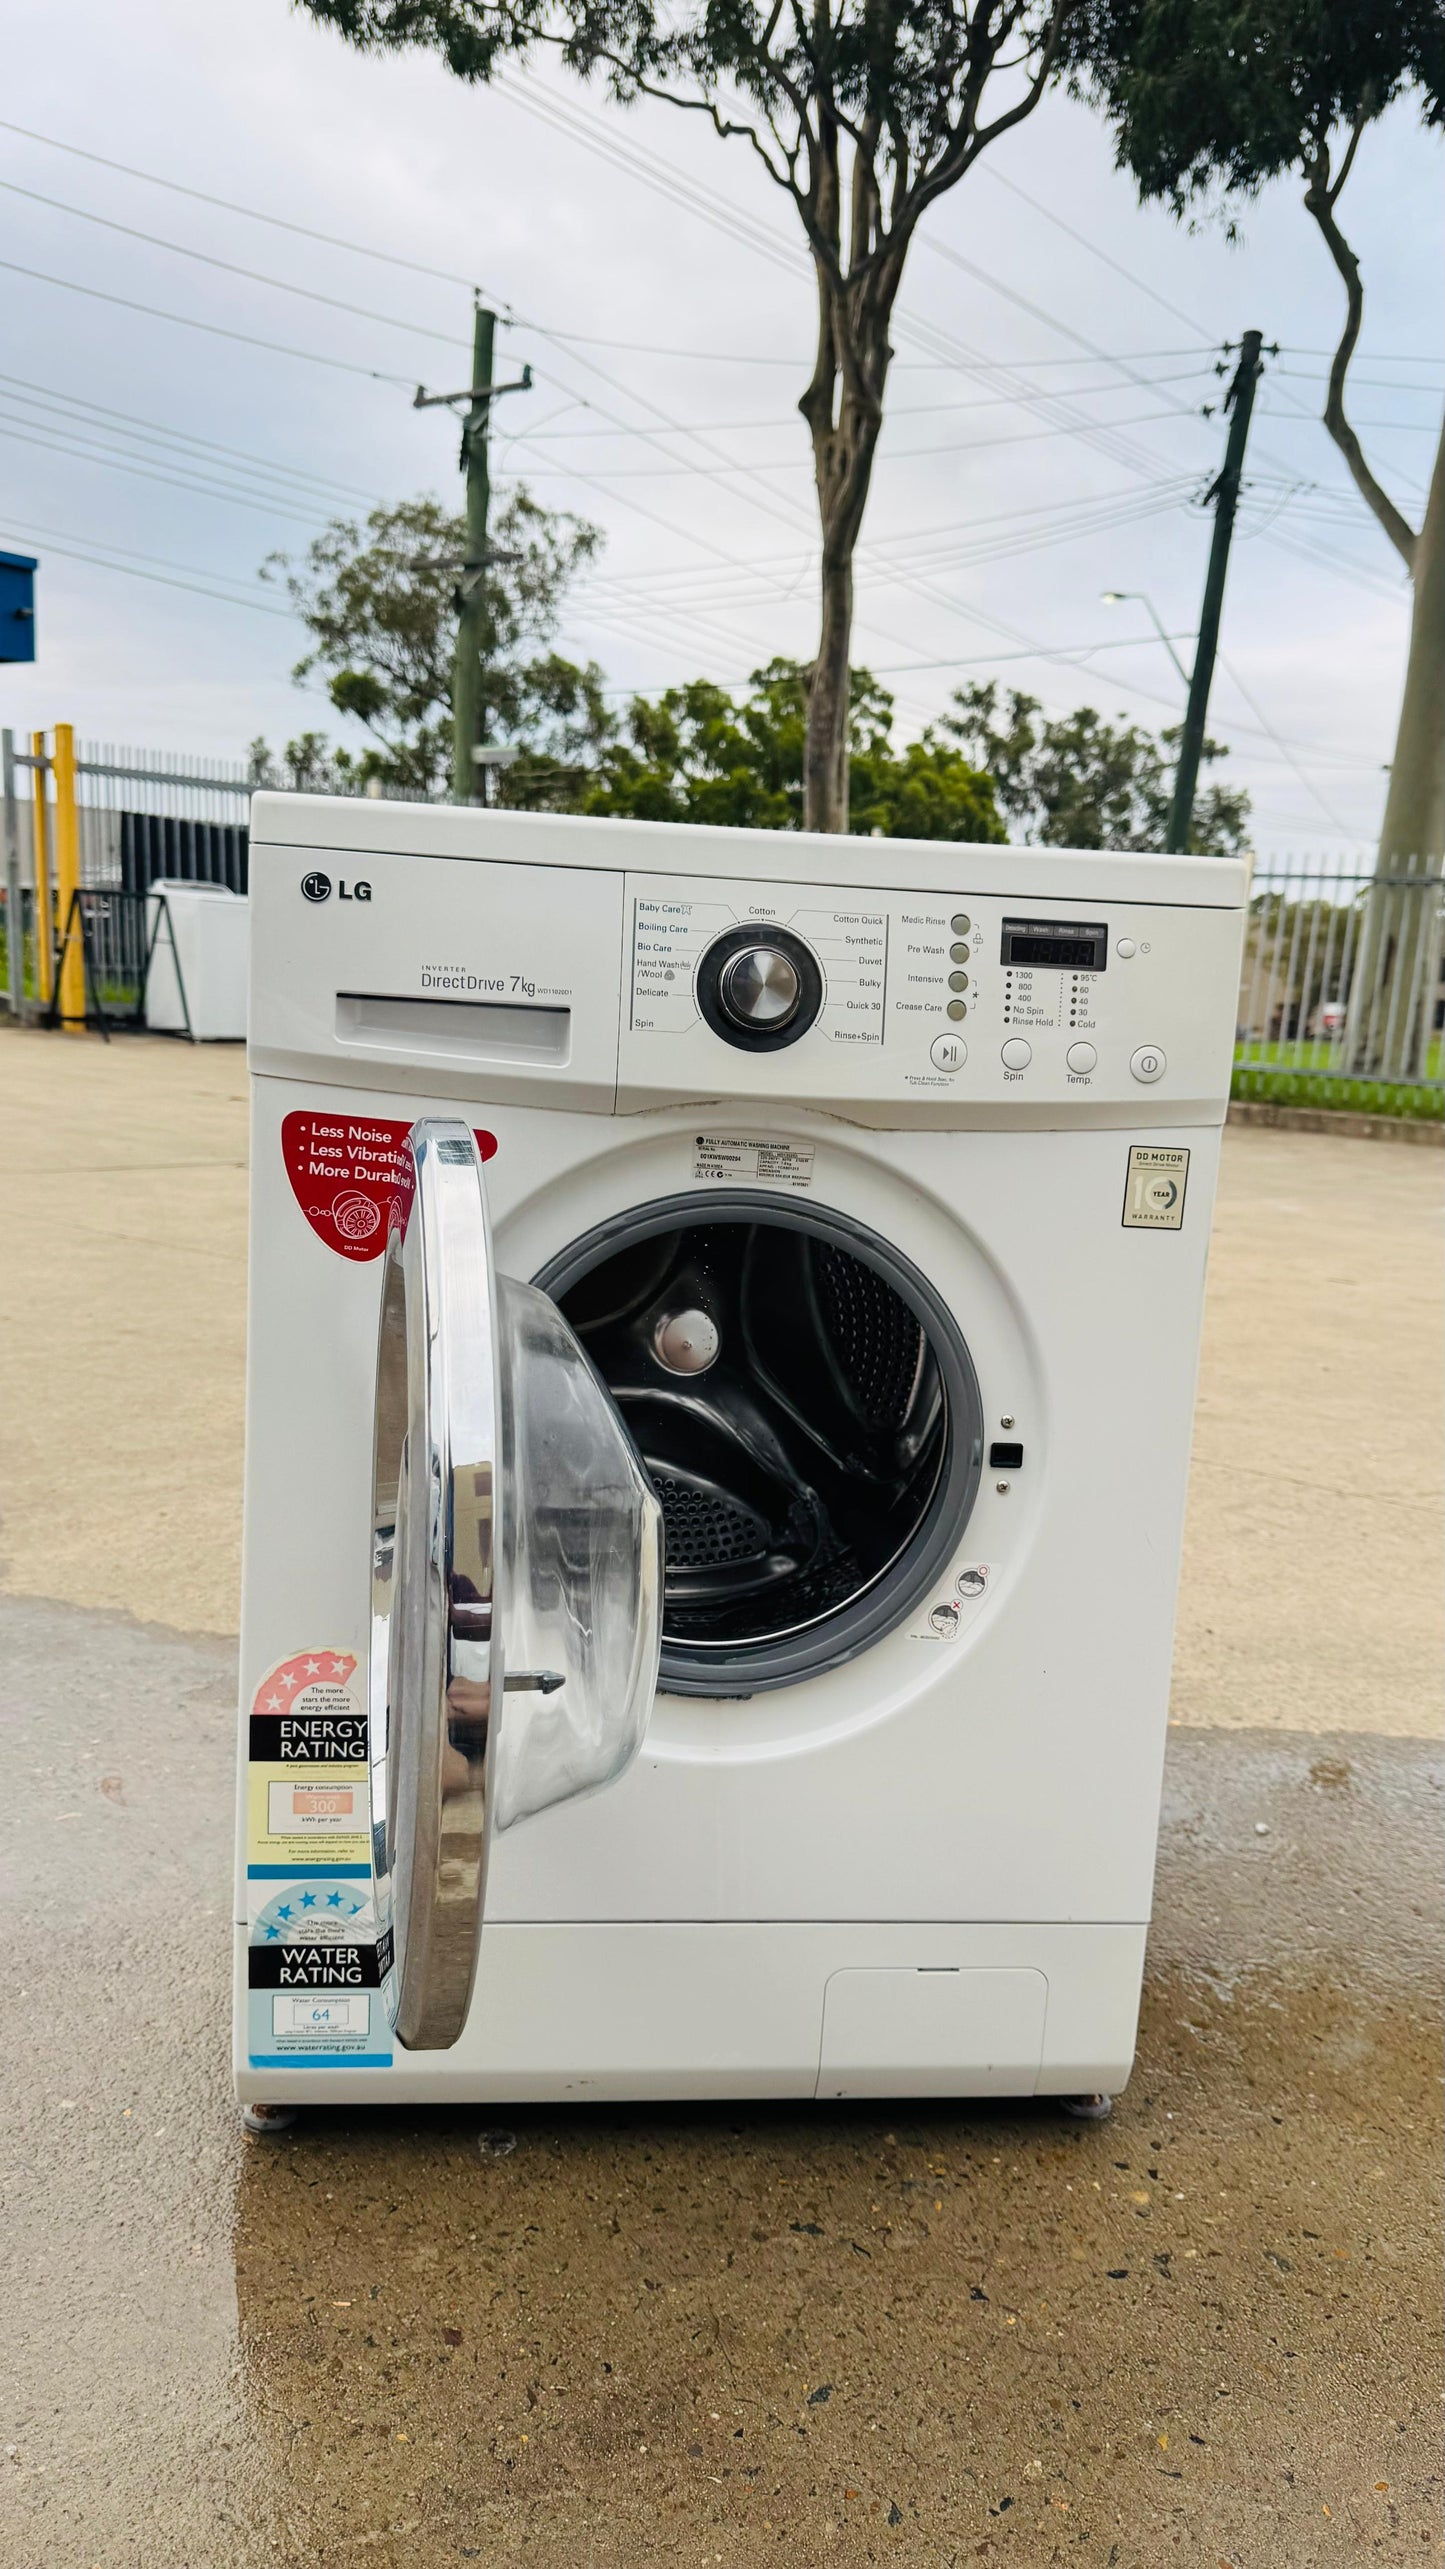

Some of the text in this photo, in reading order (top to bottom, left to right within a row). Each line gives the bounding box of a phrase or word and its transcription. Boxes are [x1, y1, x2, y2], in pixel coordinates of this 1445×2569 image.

[339, 880, 372, 901] LG
[639, 903, 681, 914] Baby Care
[749, 906, 776, 916] Cotton
[833, 915, 884, 925] Cotton Quick
[902, 916, 946, 926] Medic Rinse
[638, 923, 688, 934] Boiling Care
[845, 936, 883, 946] Synthetic
[637, 943, 672, 952] Bio Care
[907, 945, 945, 955] Pre Wash
[637, 959, 680, 969] Hand Wash
[858, 957, 882, 966] Duvet
[421, 965, 466, 973] INVERTER
[637, 970, 662, 979] /Wool
[907, 974, 944, 984] Intensive
[1015, 971, 1032, 980] 1300
[510, 975, 535, 997] 7kg
[859, 979, 881, 989] Bulky
[1018, 983, 1032, 991] 800
[636, 988, 668, 997] Delicate
[1079, 986, 1089, 994] 60
[1017, 994, 1032, 1002] 400
[846, 1002, 881, 1011] Quick 30
[896, 1002, 942, 1012] Crease Care
[1013, 1006, 1044, 1016] No Spin
[635, 1019, 654, 1029] Spin
[1012, 1017, 1054, 1027] Rinse Hold
[1078, 1020, 1096, 1028] Cold
[834, 1031, 880, 1042] Rinse+Spin
[1003, 1072, 1024, 1082] Spin
[1066, 1074, 1093, 1086] Temp.
[311, 1122, 392, 1143] Less Noise
[310, 1141, 397, 1164] Less Vibrati
[1136, 1152, 1183, 1162] DD MOTOR
[309, 1161, 395, 1183] More Dura
[281, 1721, 368, 1738] ENERGY
[281, 1741, 365, 1758] RATING
[310, 1800, 336, 1813] 300
[282, 1948, 360, 1964] WATER
[280, 1967, 362, 1984] RATING
[312, 2008, 330, 2021] 64
[276, 2044, 366, 2052] www.waterrating.gov.au
